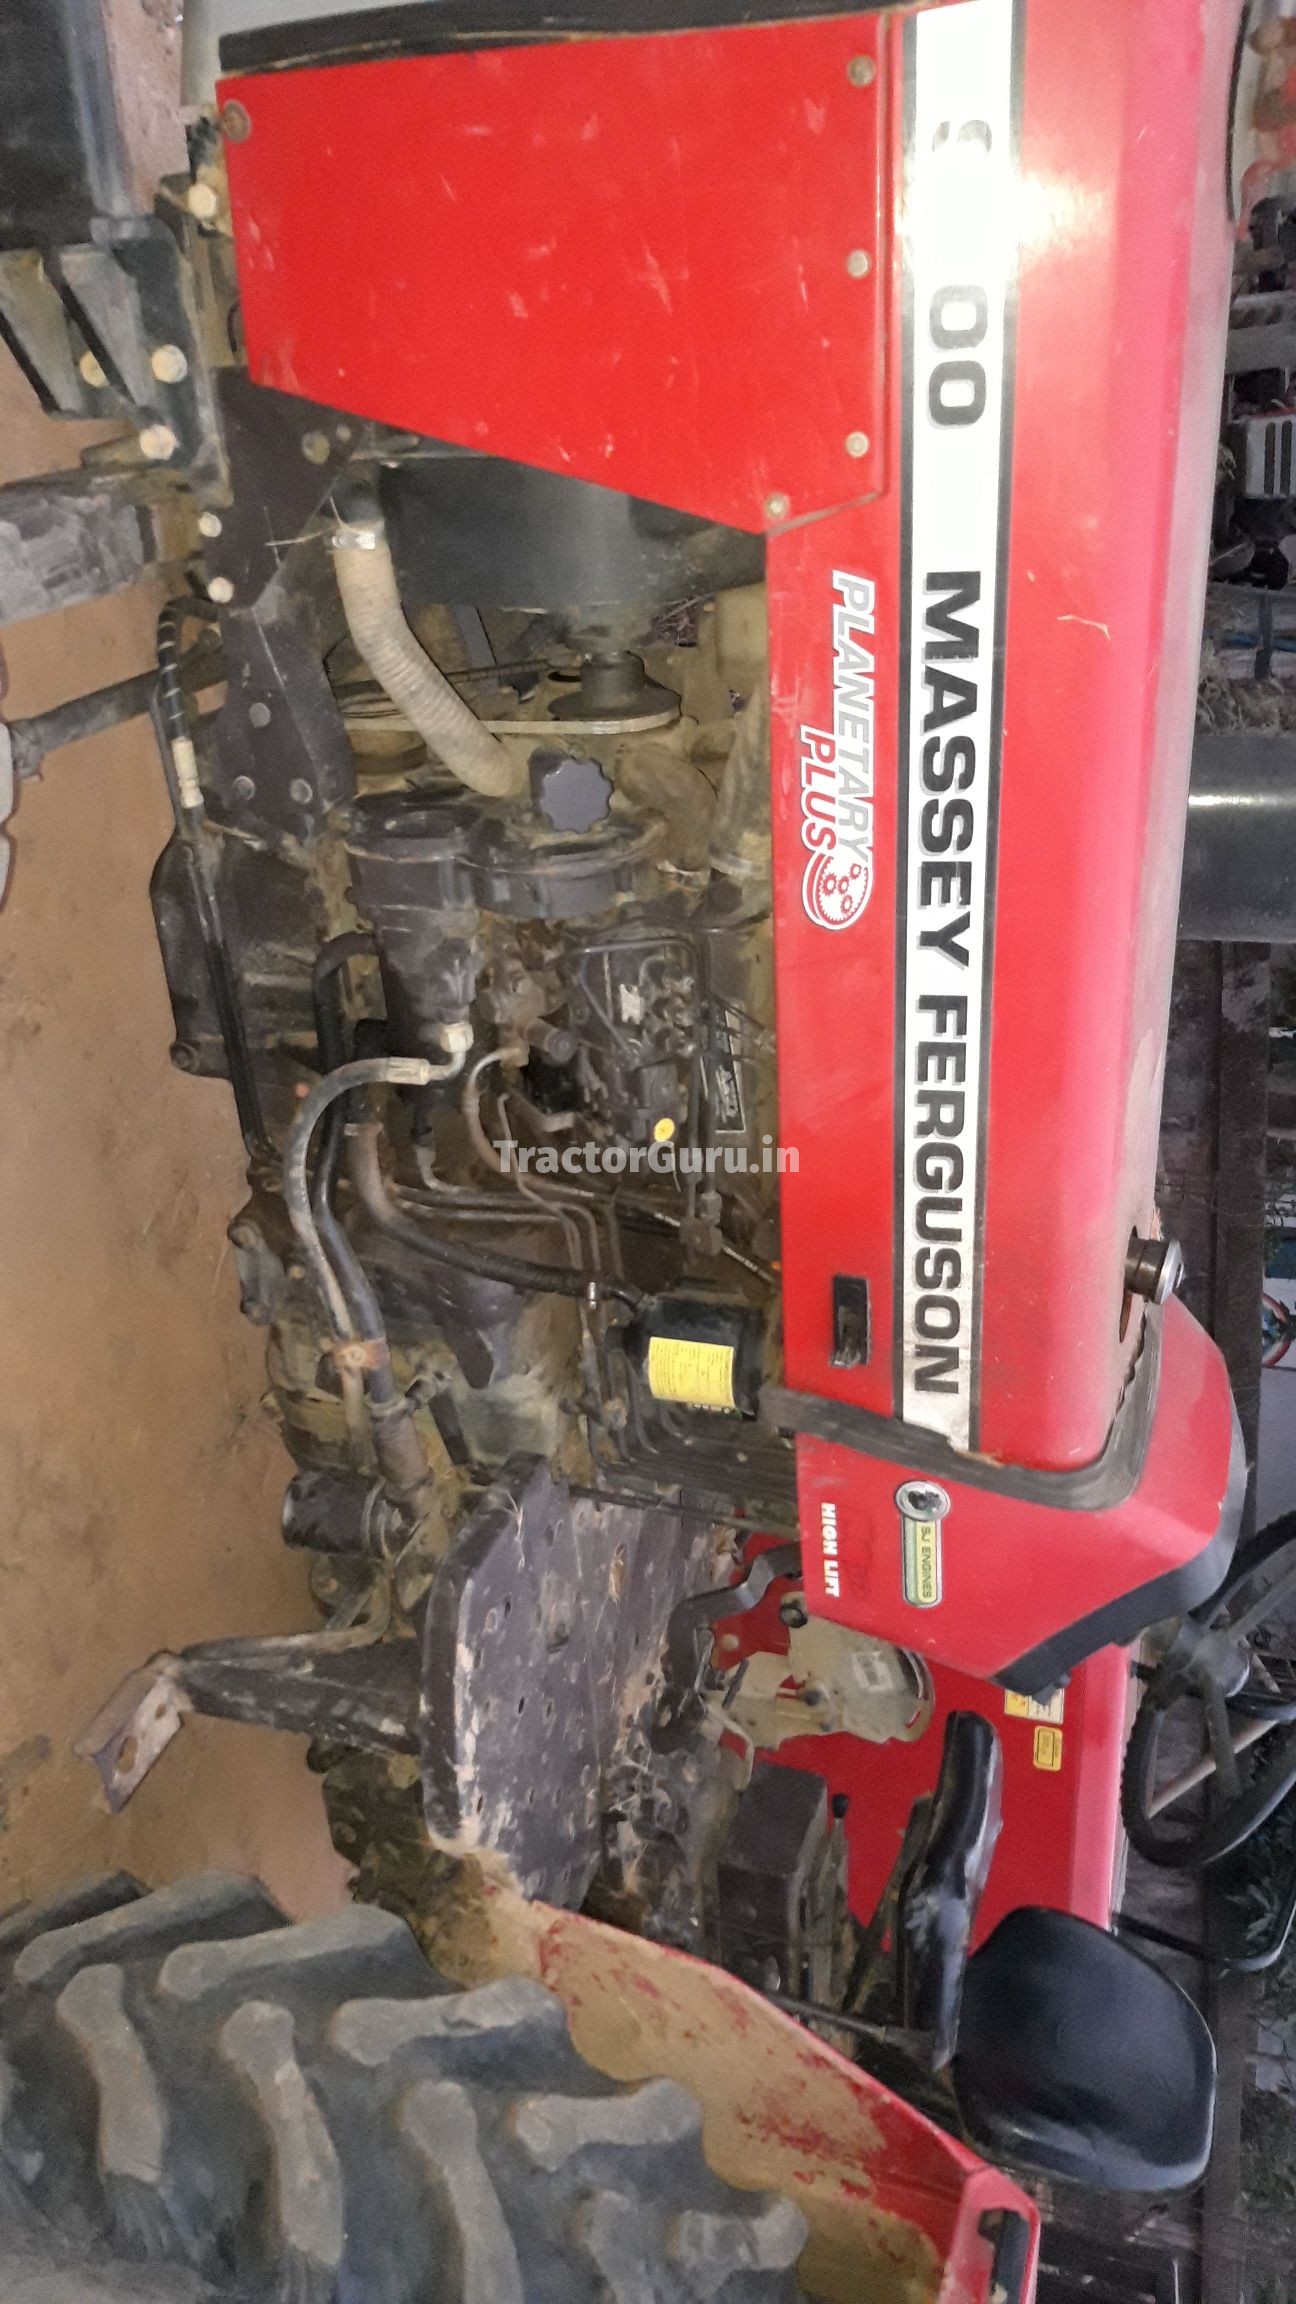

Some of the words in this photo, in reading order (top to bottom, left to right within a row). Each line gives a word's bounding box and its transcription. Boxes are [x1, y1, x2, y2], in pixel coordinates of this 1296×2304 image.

[835, 574, 873, 864] PLANETARY
[918, 571, 982, 968] MASSEY
[802, 728, 837, 852] PLUS
[912, 994, 969, 1394] FERGUSON
[821, 1503, 838, 1554] HIGH
[823, 1559, 840, 1597] LIFT
[921, 1546, 933, 1598] ENGINES
